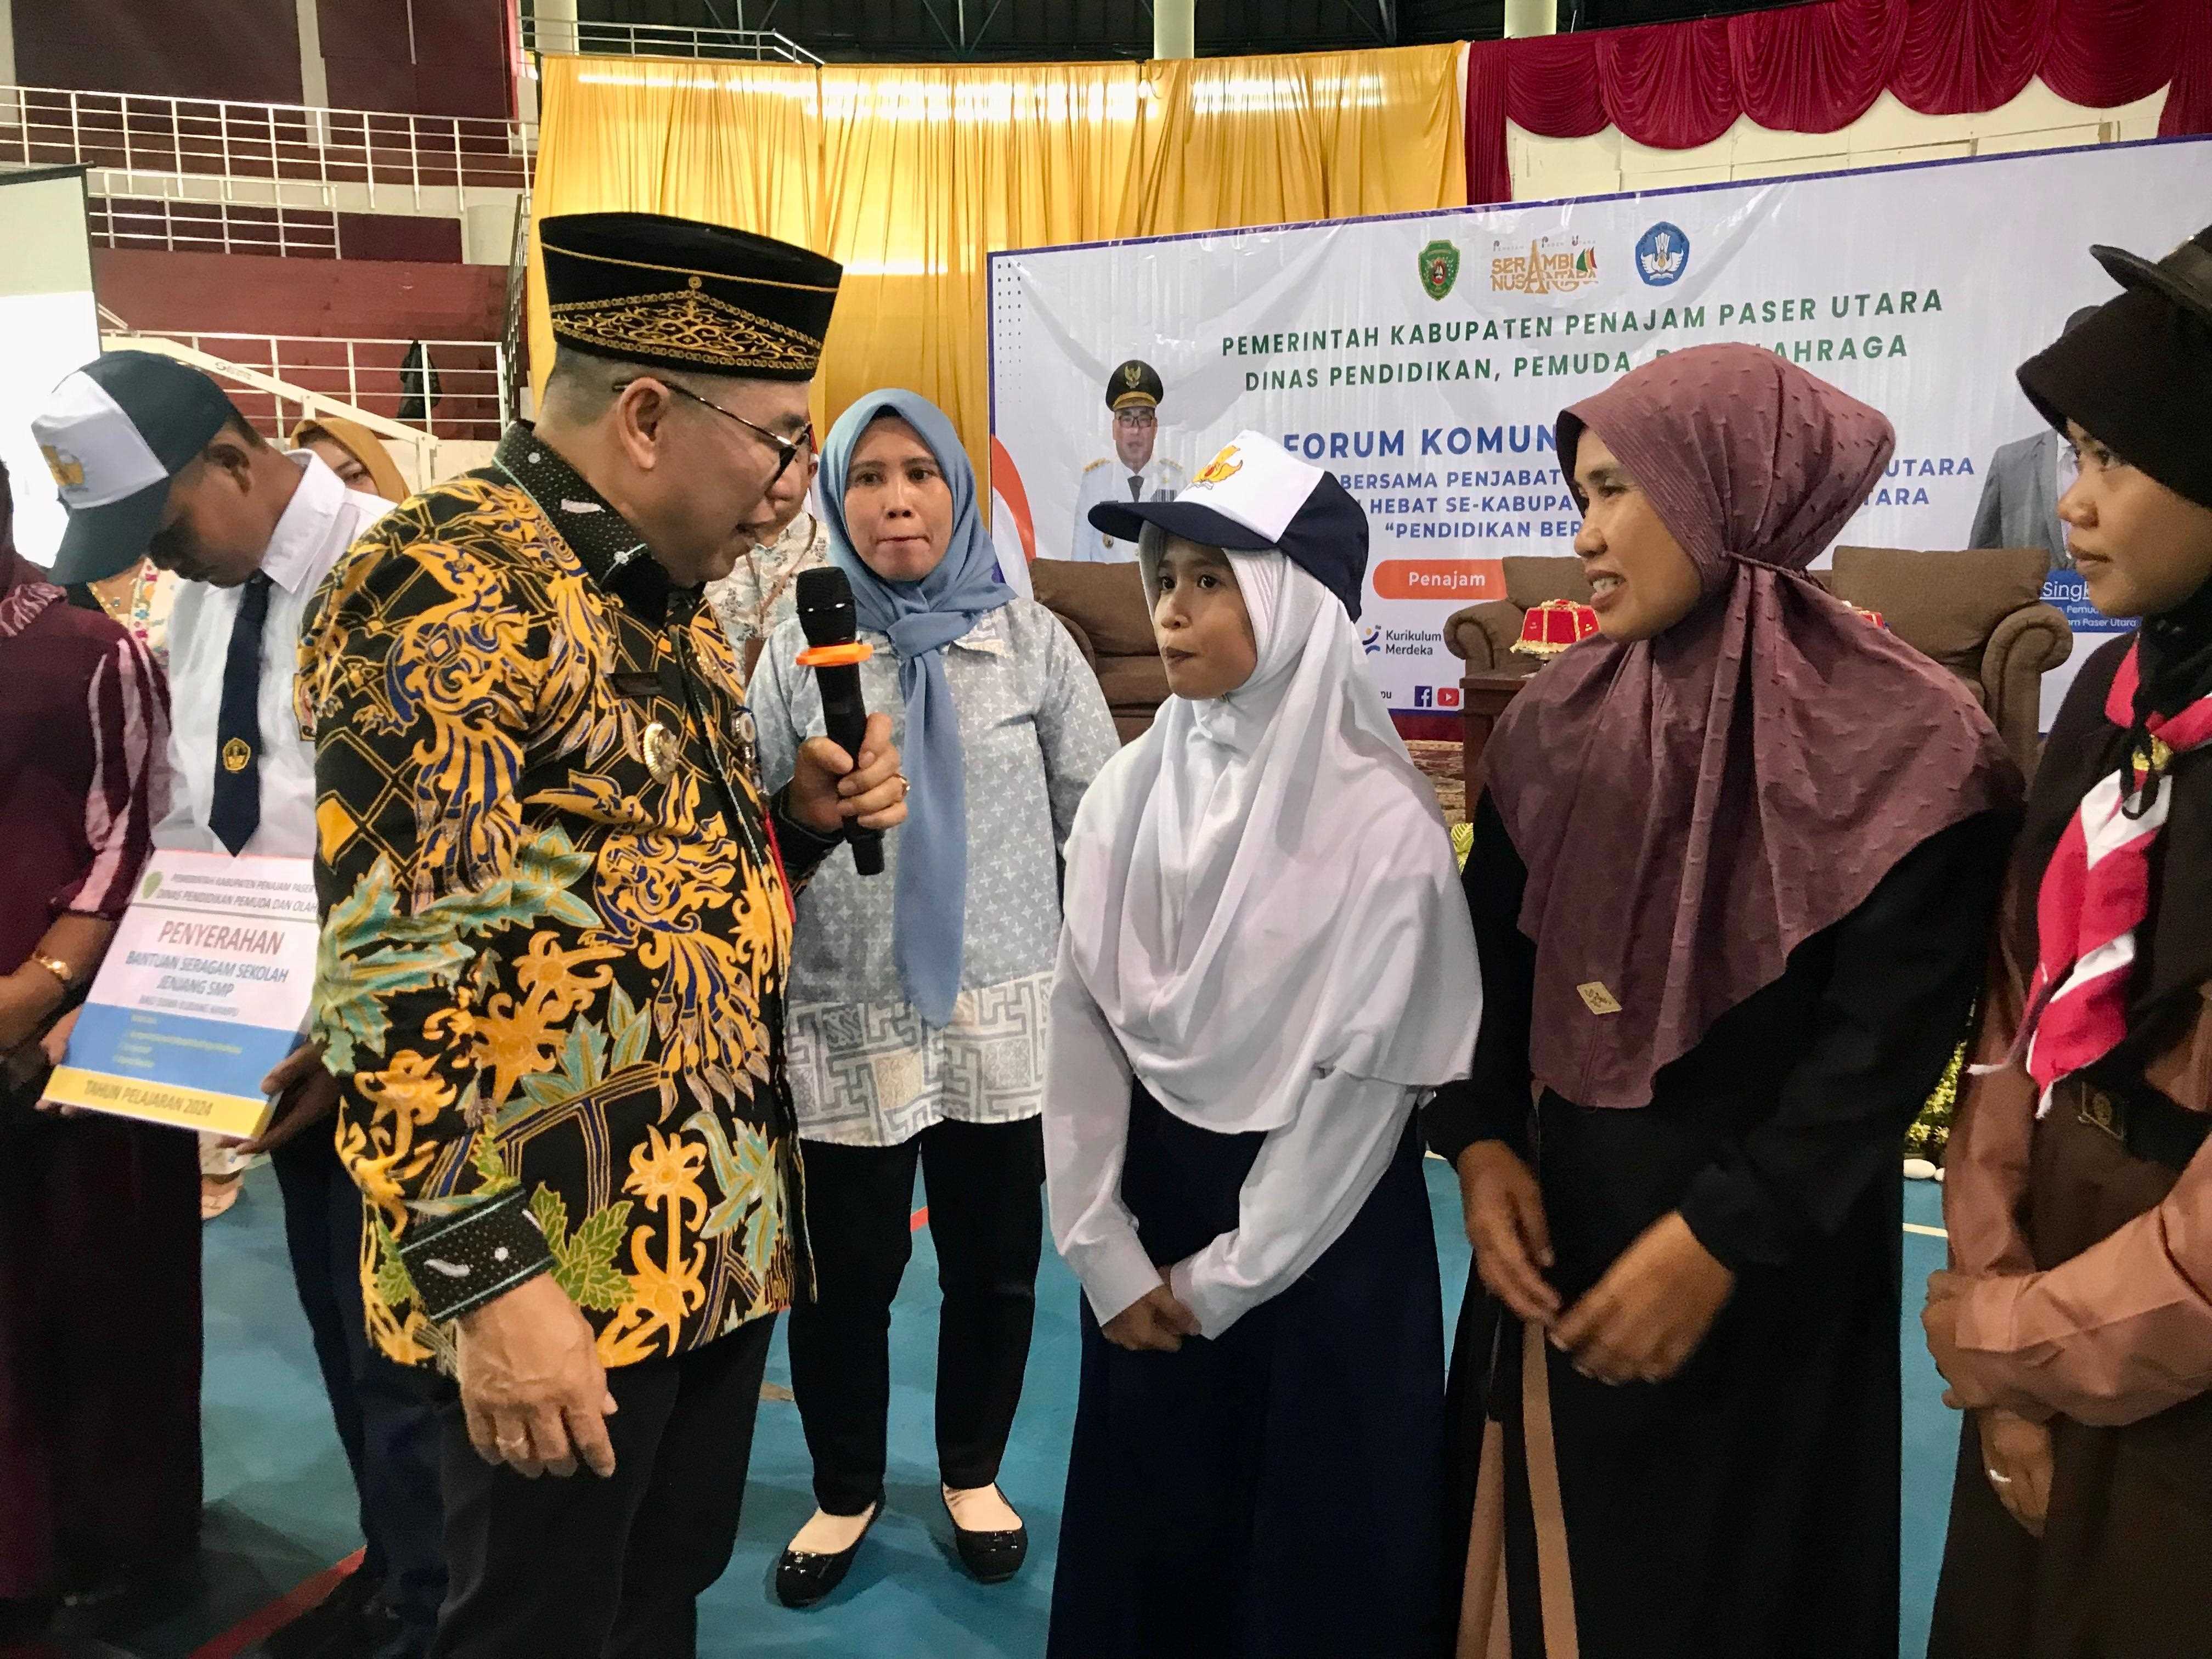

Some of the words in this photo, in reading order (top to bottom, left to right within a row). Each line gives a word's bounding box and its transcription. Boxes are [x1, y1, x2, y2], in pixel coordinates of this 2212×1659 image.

[1222, 326, 1379, 356] PEMERINTAH
[1391, 317, 1553, 346] KABUPATEN
[1565, 306, 1705, 336] PENAJAM
[1719, 297, 1816, 326] PASER
[1831, 289, 1943, 319] UTARA
[1245, 367, 1318, 392] DINAS
[1330, 358, 1500, 387] PENDIDIKAN,
[1514, 351, 1631, 377] PEMUDA
[1284, 430, 1404, 459] FORUM
[1340, 472, 1438, 490] BERSAMA
[1447, 469, 1561, 487] PENJABAT
[1884, 457, 1974, 477] UTARA
[1370, 497, 1438, 515] HEBAT
[1446, 495, 1573, 514] SE-KABUPA
[1409, 570, 1485, 590] Penajam
[1386, 629, 1441, 642] Kurikulum
[1386, 644, 1434, 656] Merdeka
[157, 920, 285, 956] PENYERAHAN
